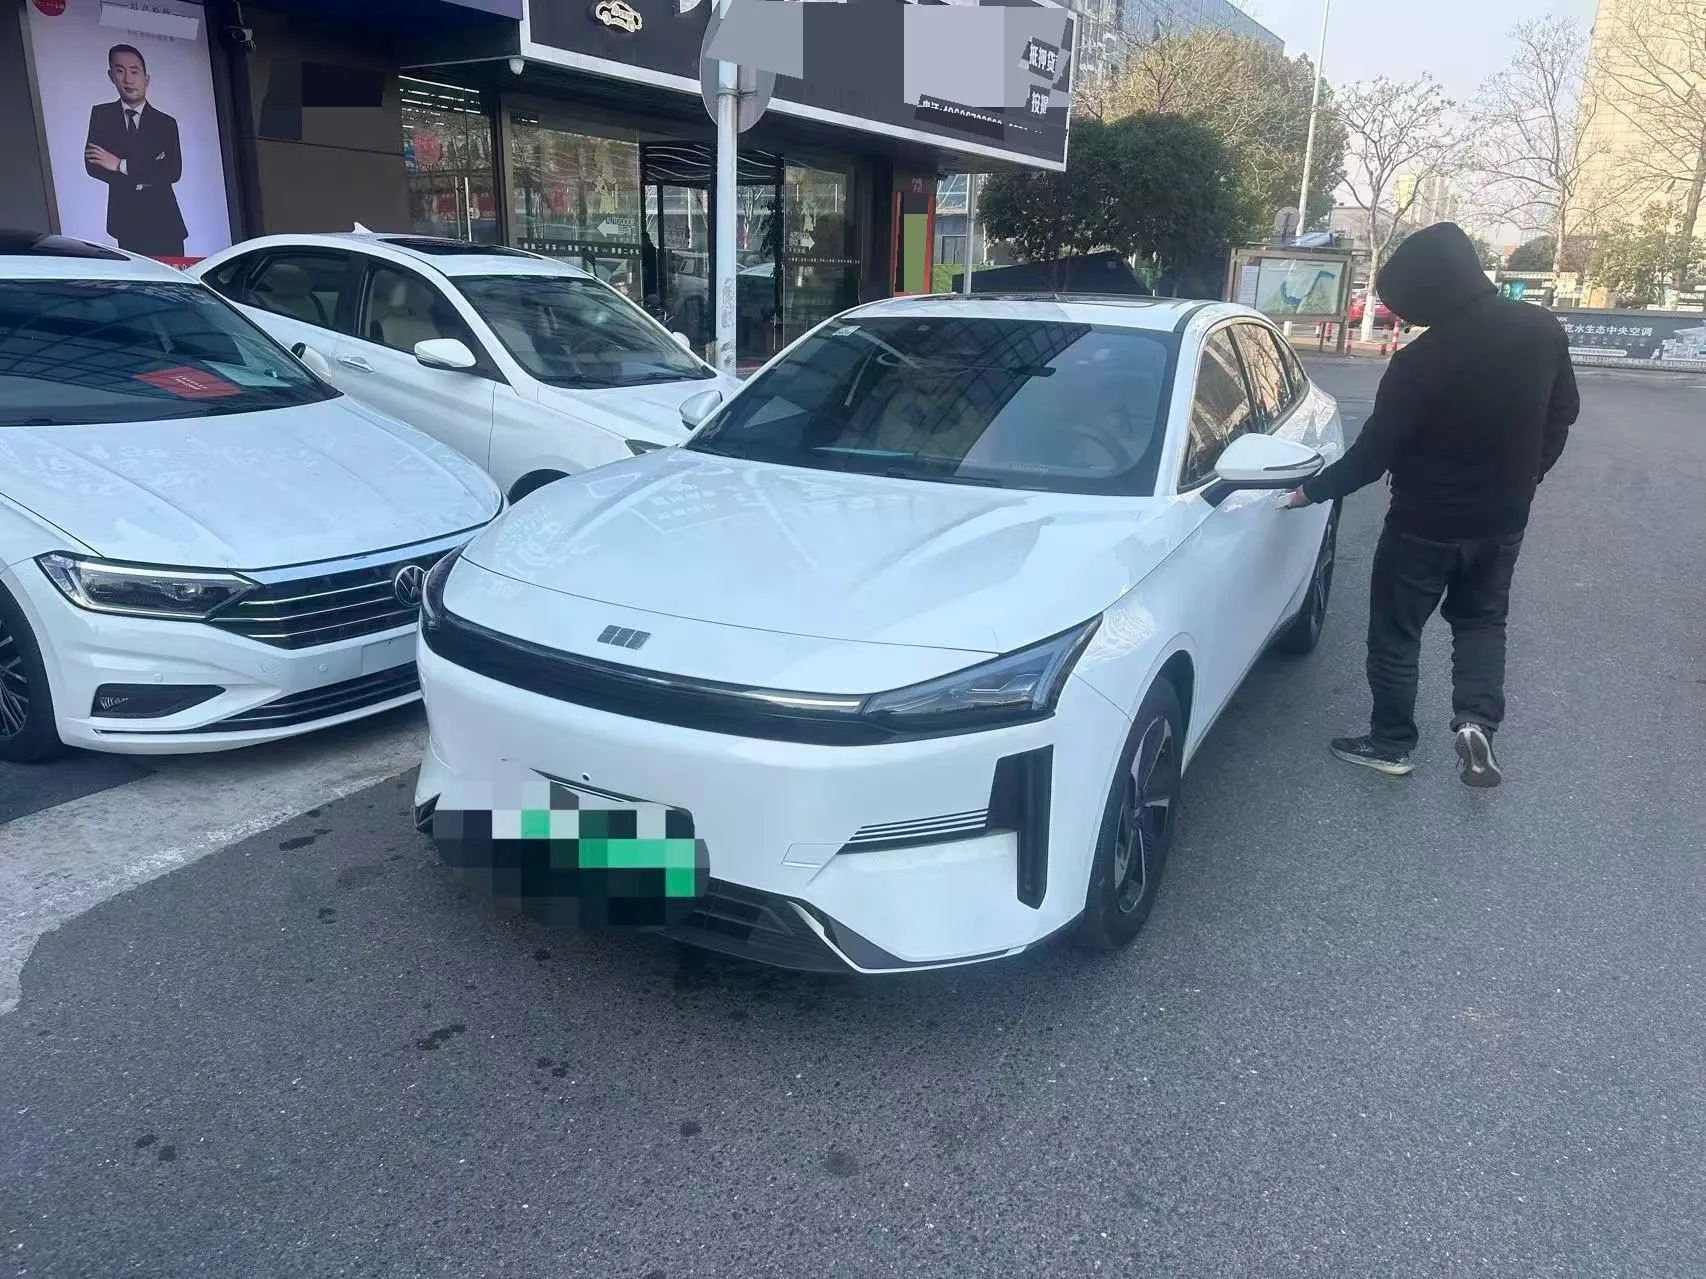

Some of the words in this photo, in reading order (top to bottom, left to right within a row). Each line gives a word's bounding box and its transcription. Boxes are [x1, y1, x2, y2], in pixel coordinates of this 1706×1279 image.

[1562, 323, 1653, 337] 克水生态中央空调
